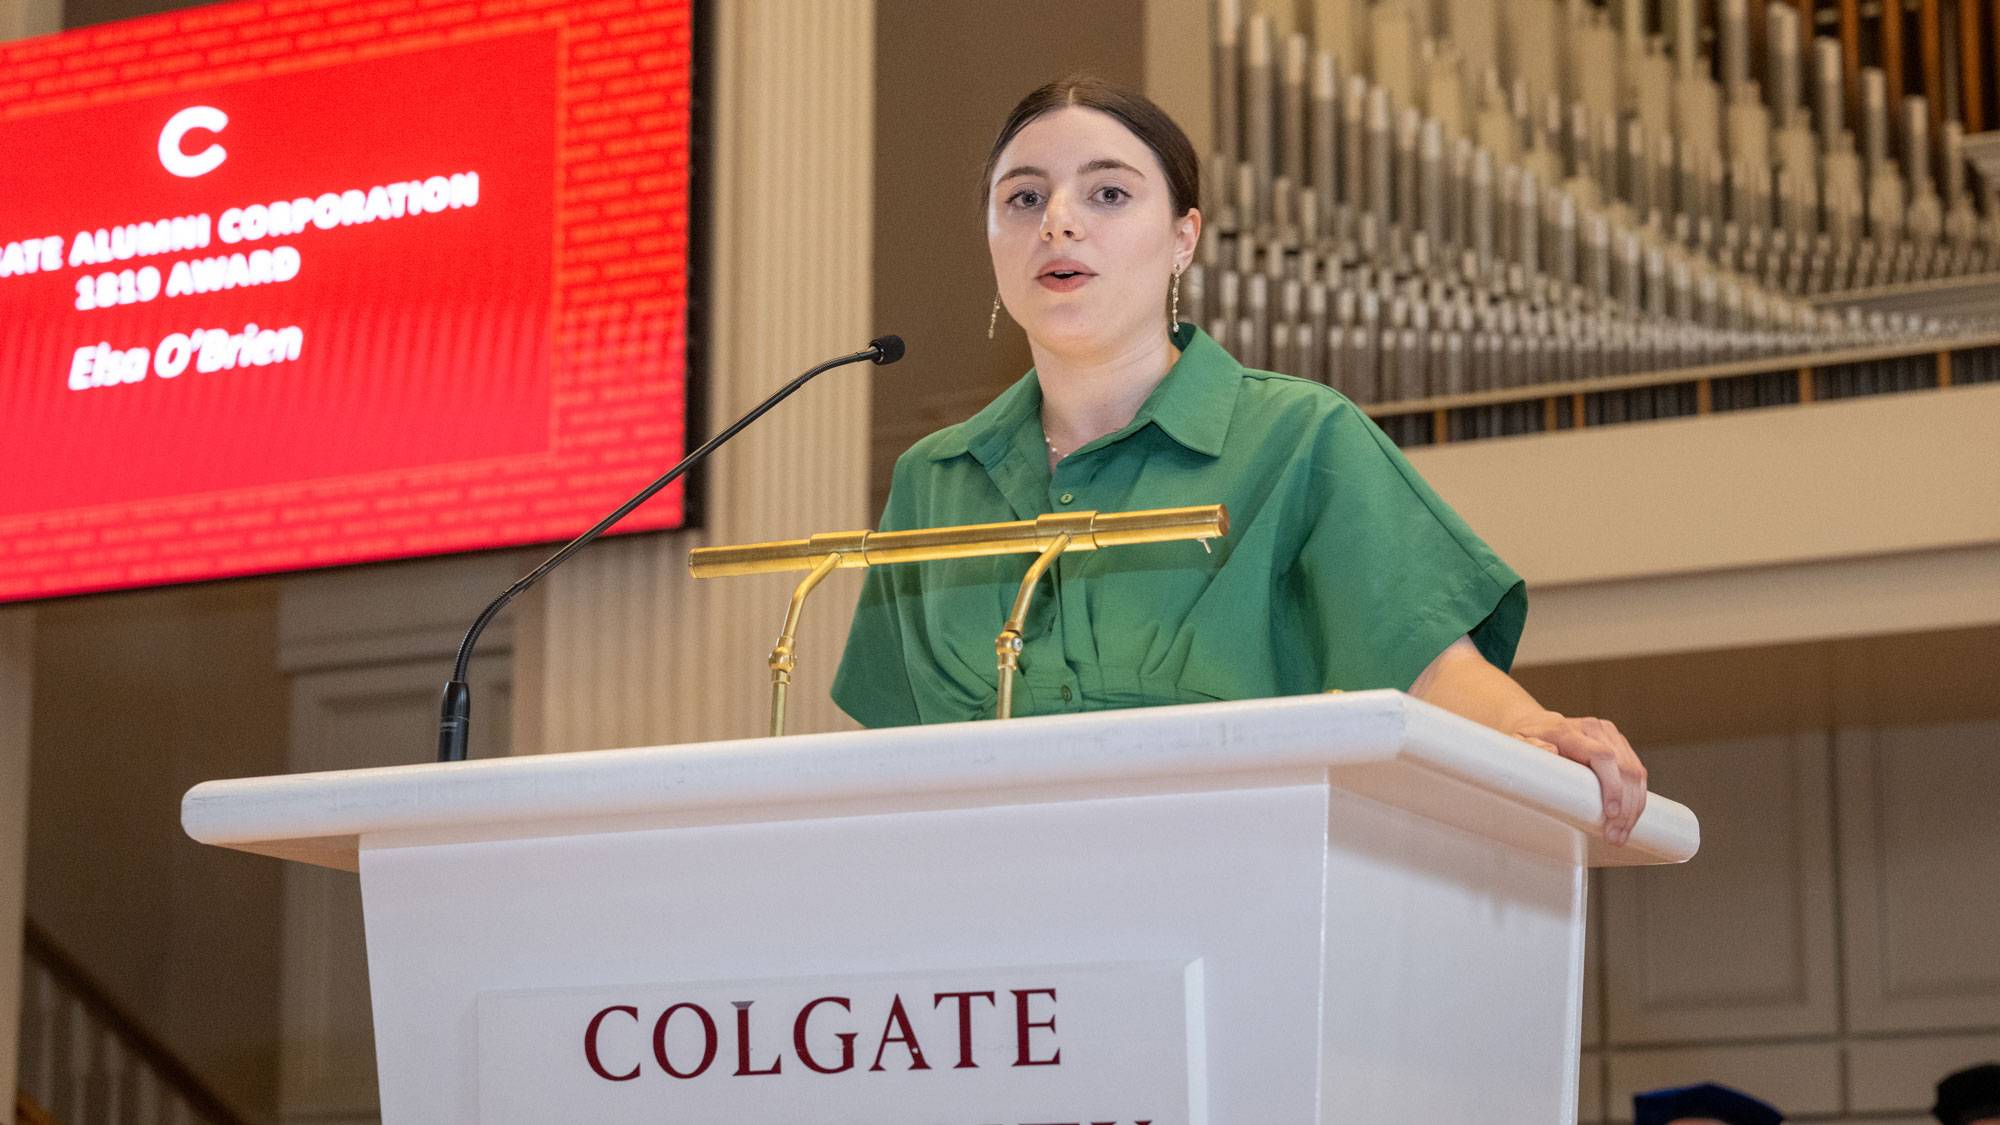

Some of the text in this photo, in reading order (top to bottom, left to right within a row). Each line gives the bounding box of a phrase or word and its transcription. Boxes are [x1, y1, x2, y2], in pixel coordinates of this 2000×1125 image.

[157, 105, 229, 178] C
[0, 171, 480, 278] ATE ALUMNI CORPORATION
[75, 245, 301, 311] 1819 AWARD
[68, 323, 304, 391] Elsa O'Brien
[584, 988, 1061, 1081] COLGATE
